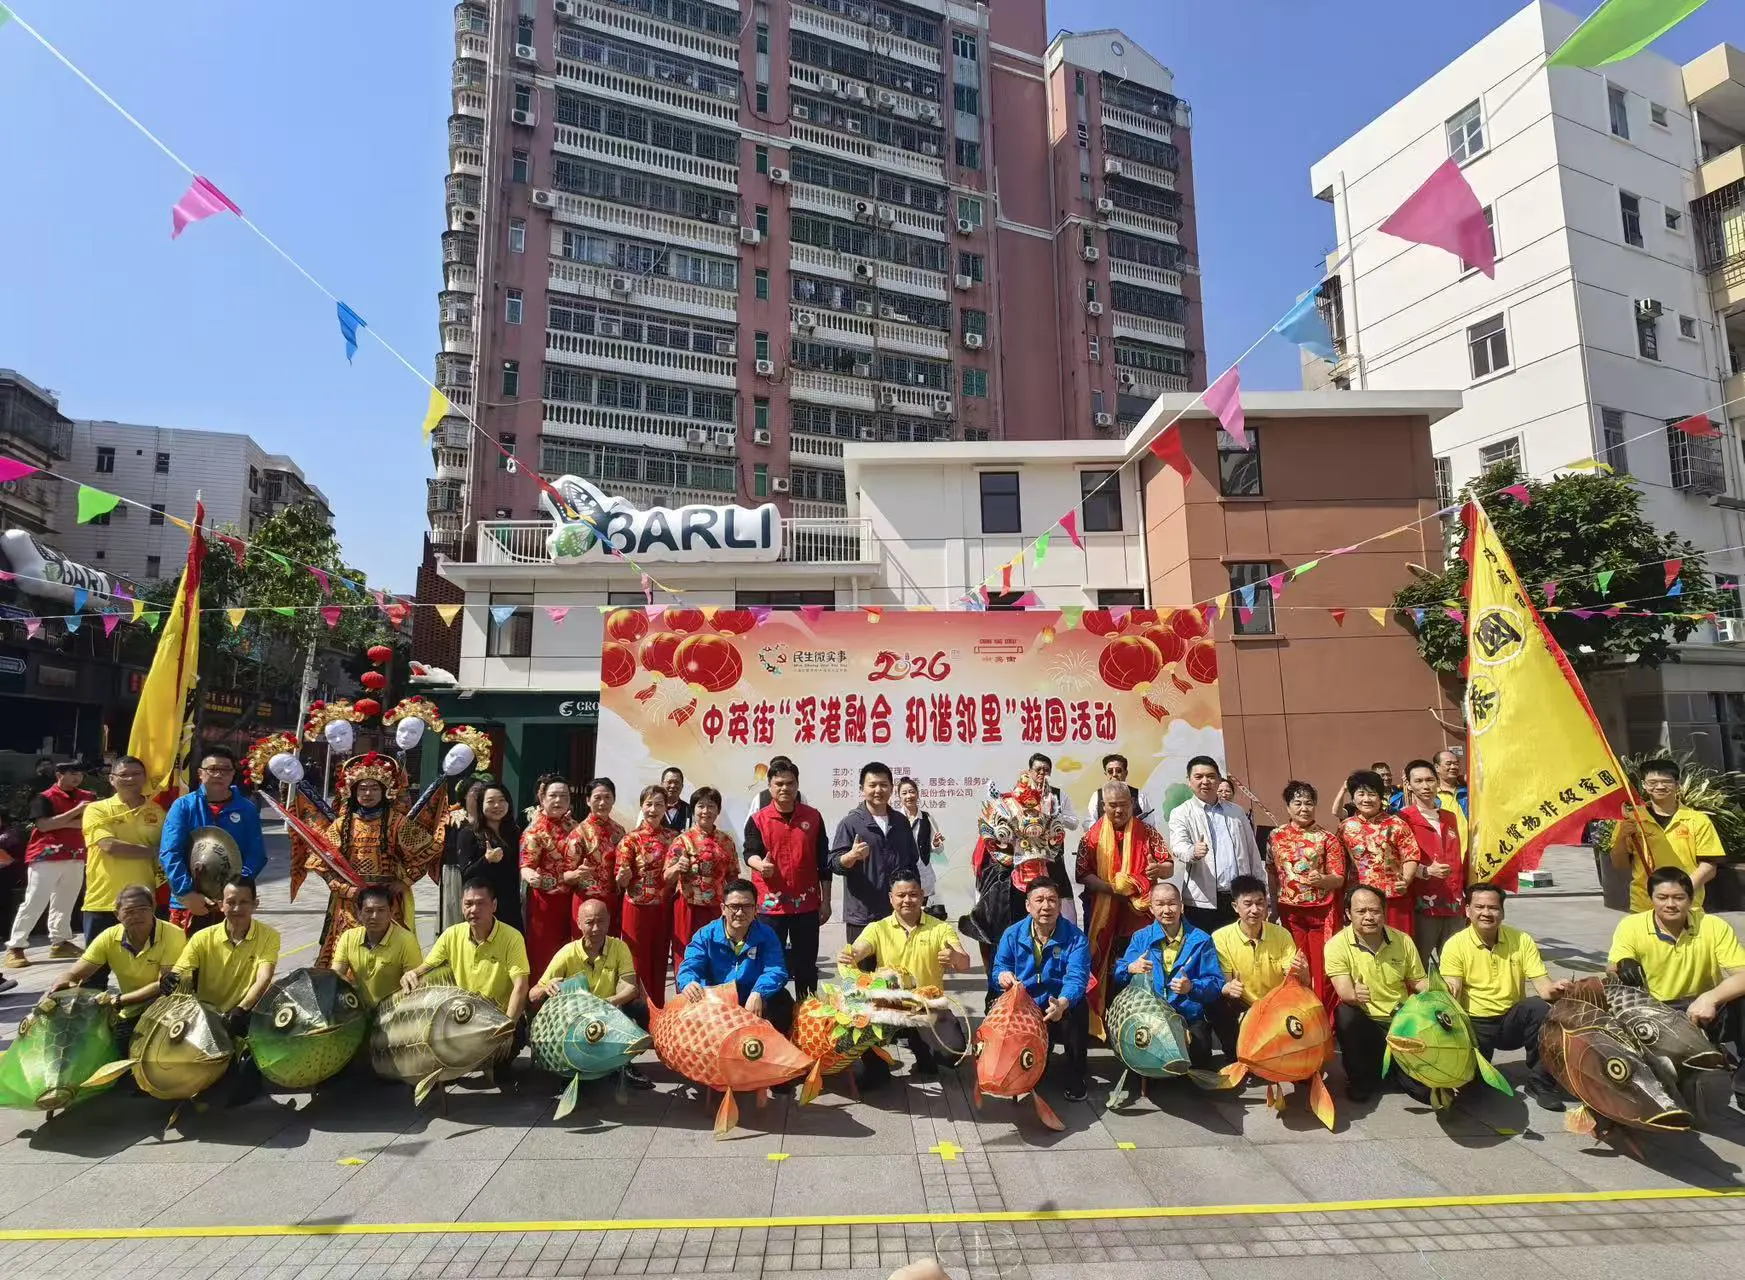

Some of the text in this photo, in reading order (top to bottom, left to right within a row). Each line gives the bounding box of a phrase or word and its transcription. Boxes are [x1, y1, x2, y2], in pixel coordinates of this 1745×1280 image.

[602, 508, 771, 554] BARLI
[793, 650, 847, 663] 民生微实事
[868, 651, 951, 681] 2026
[702, 694, 1118, 745] 中英街“深港融合 和谐邻里”游园活动
